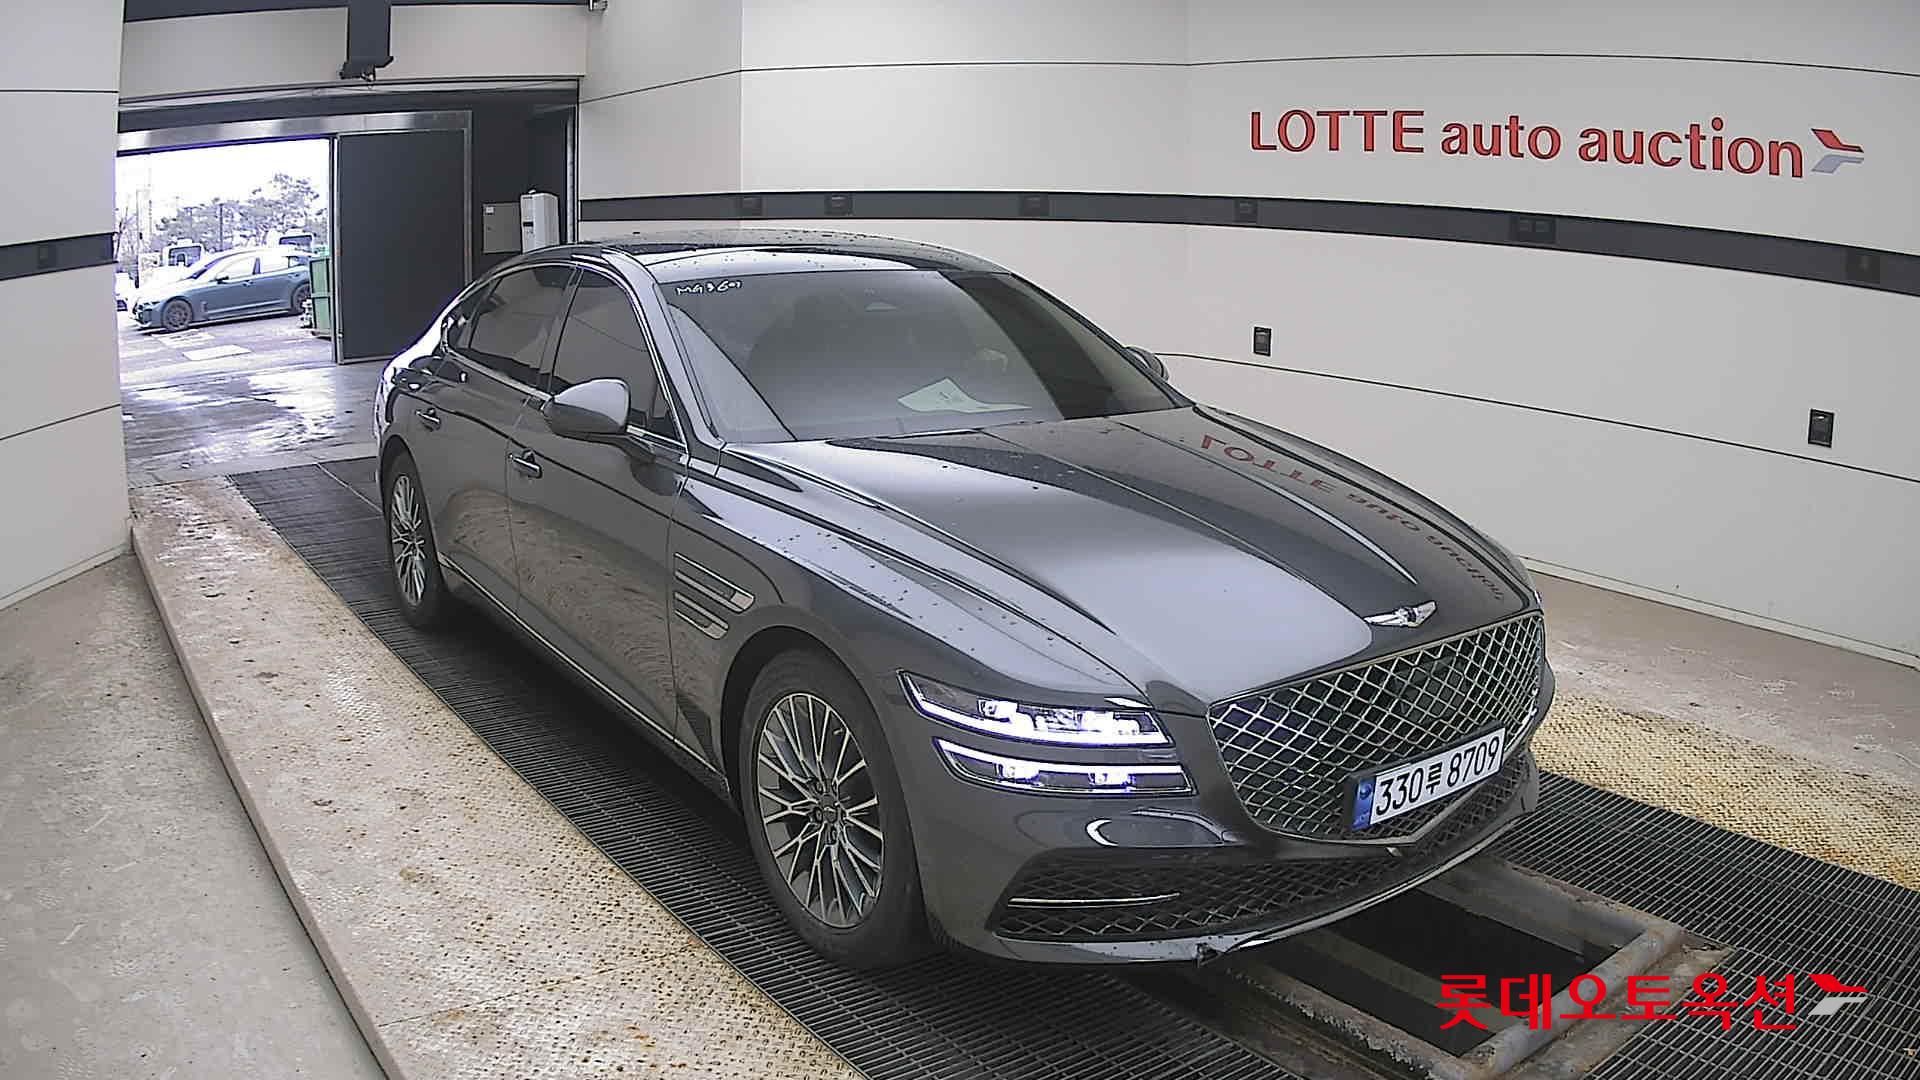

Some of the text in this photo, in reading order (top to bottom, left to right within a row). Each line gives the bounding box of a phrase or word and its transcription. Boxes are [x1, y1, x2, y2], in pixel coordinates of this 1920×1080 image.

[1250, 110, 1805, 178] LOTTE auto auction
[1375, 736, 1500, 816] 330루 8709
